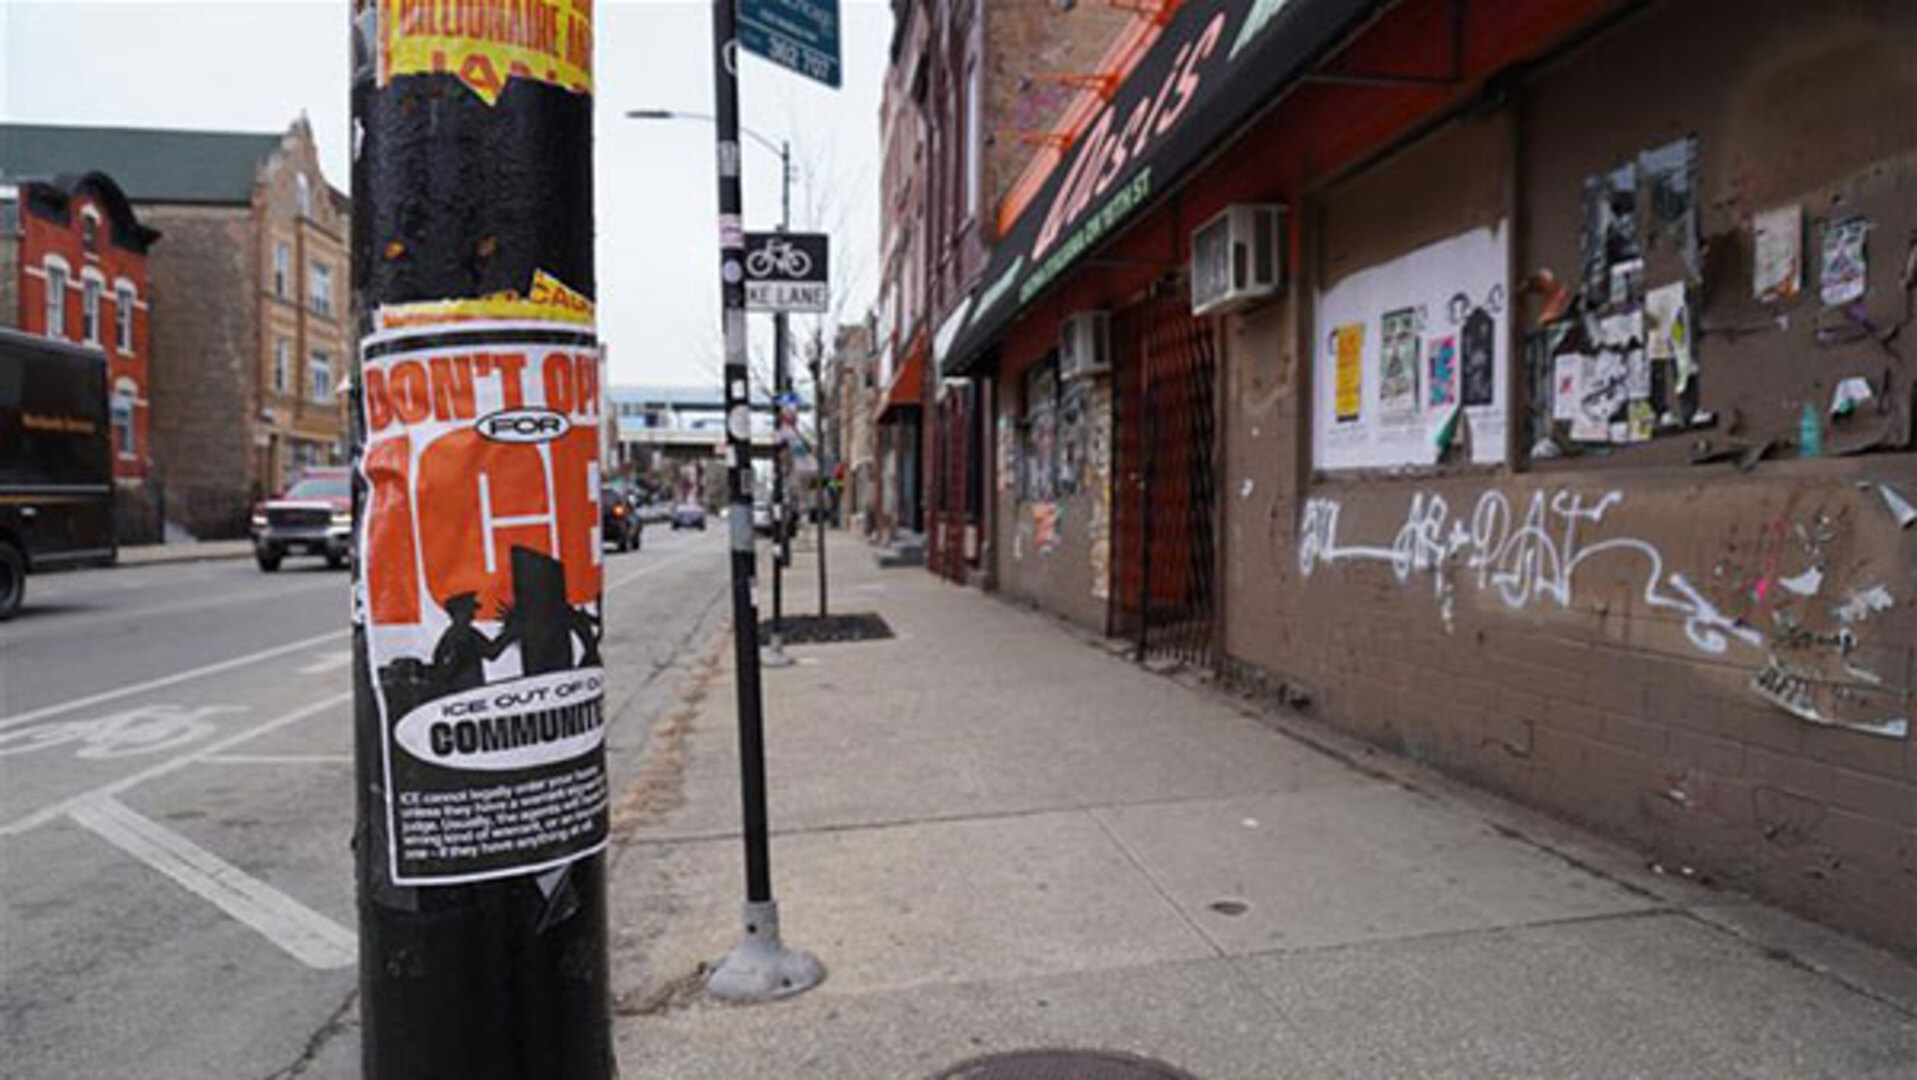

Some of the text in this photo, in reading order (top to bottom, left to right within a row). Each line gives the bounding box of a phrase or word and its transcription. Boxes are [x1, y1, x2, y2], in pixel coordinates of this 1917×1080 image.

[775, 285, 824, 301] LANE
[365, 353, 527, 432] DON'T
[489, 416, 560, 435] FOR
[365, 424, 602, 626] ICE
[442, 699, 489, 717] ICE
[494, 686, 550, 709] OUT
[556, 680, 583, 697] OF
[400, 791, 419, 805] ICE
[423, 790, 466, 804] cannot
[469, 785, 511, 802] legally
[444, 805, 470, 818] they
[476, 801, 505, 812] have
